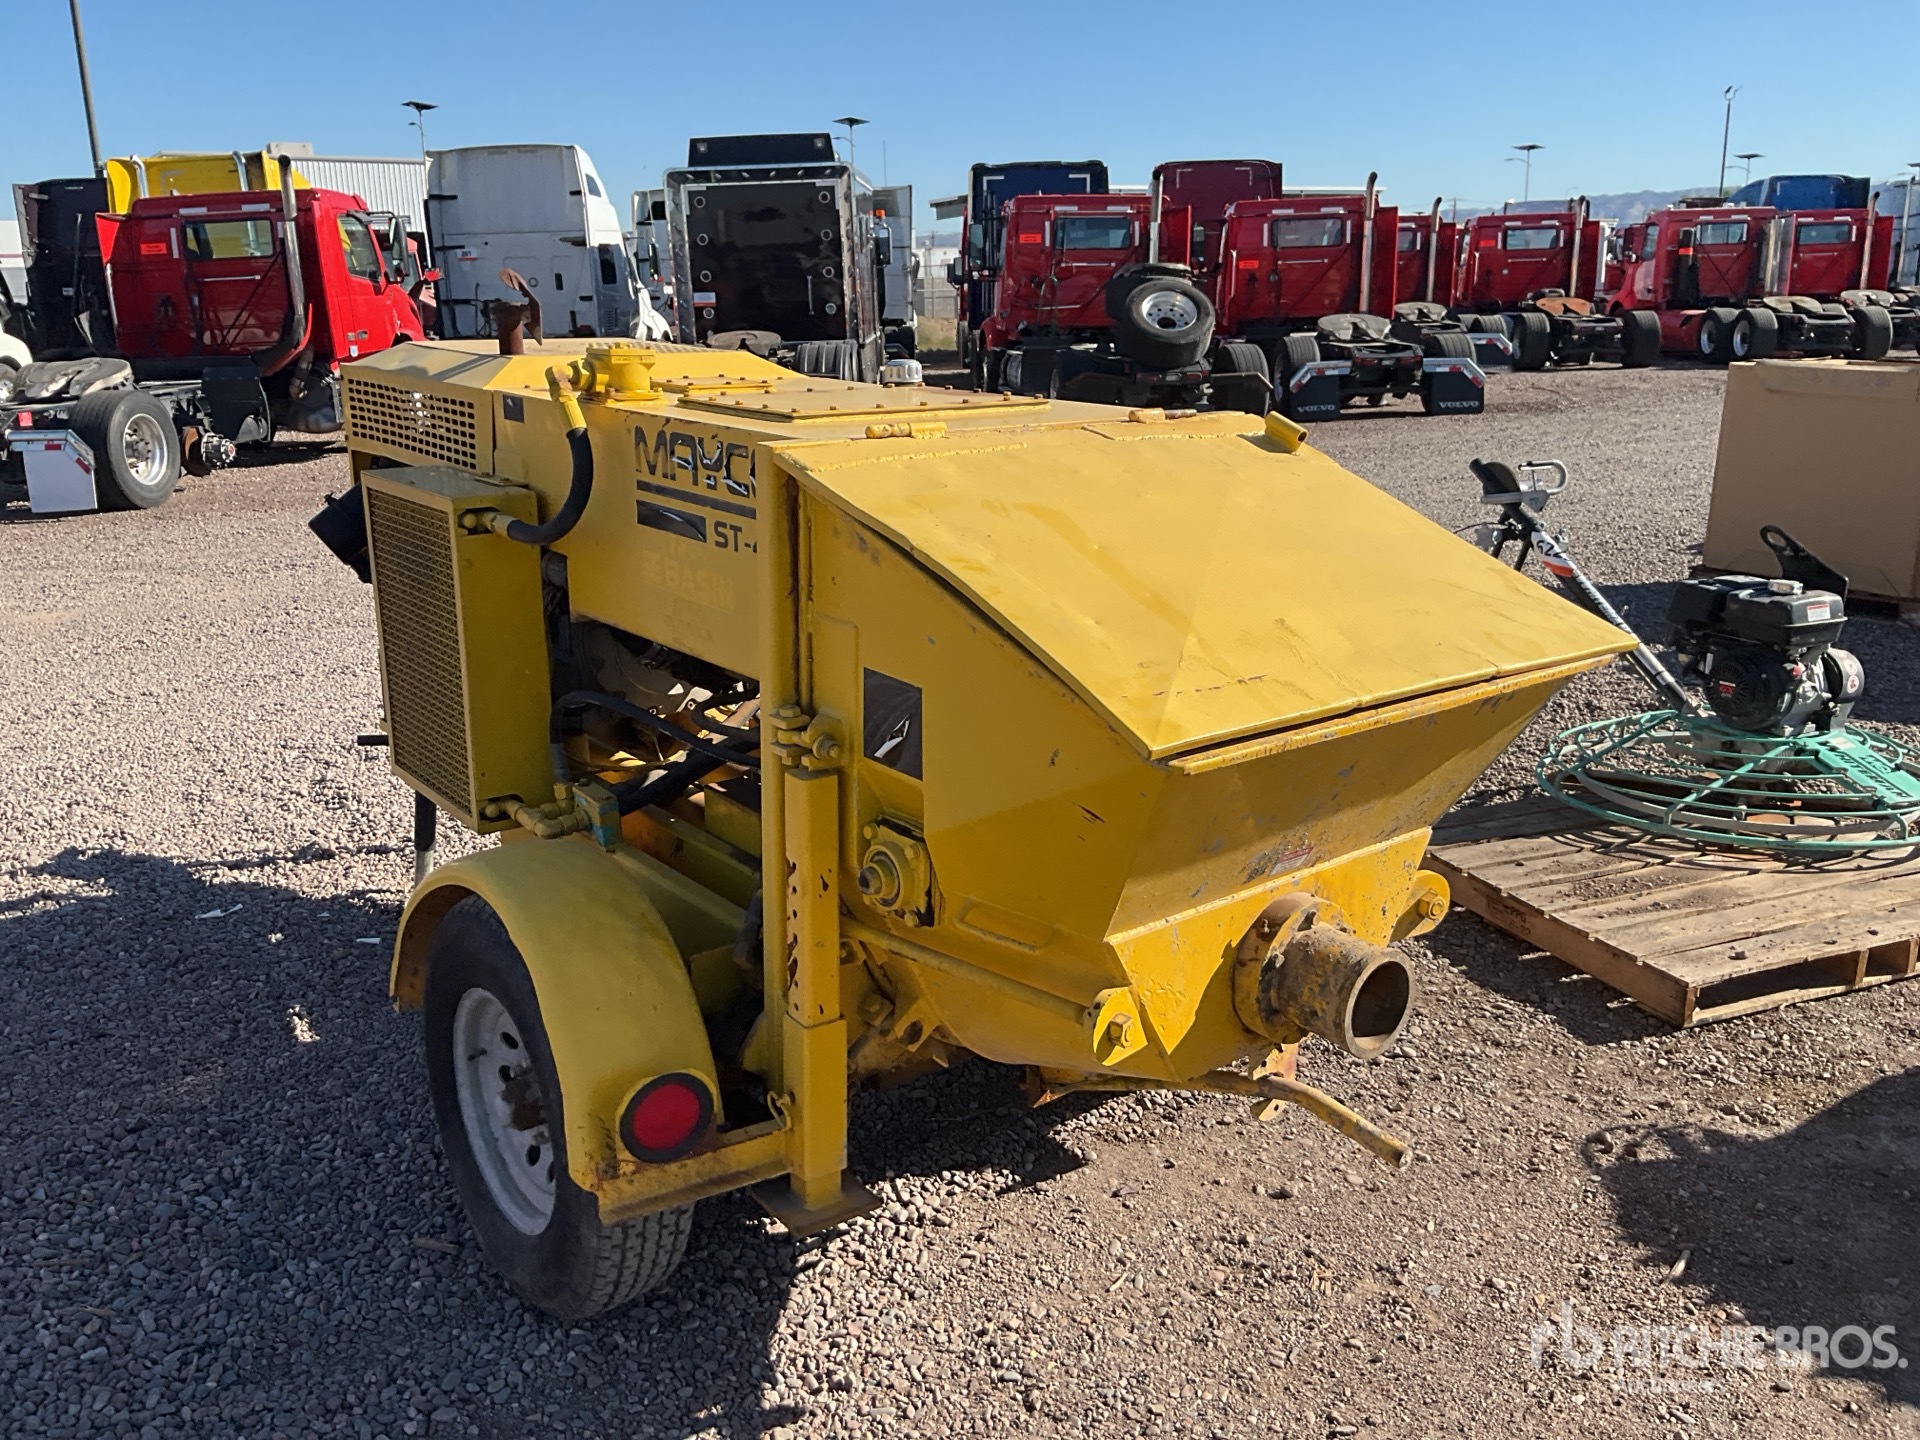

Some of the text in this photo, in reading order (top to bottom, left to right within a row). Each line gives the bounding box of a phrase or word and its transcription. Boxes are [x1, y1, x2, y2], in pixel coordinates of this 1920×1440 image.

[1297, 404, 1336, 413] VOLVO
[1438, 400, 1480, 409] VOLVO
[633, 425, 757, 499] MAYC
[713, 521, 758, 554] ST-
